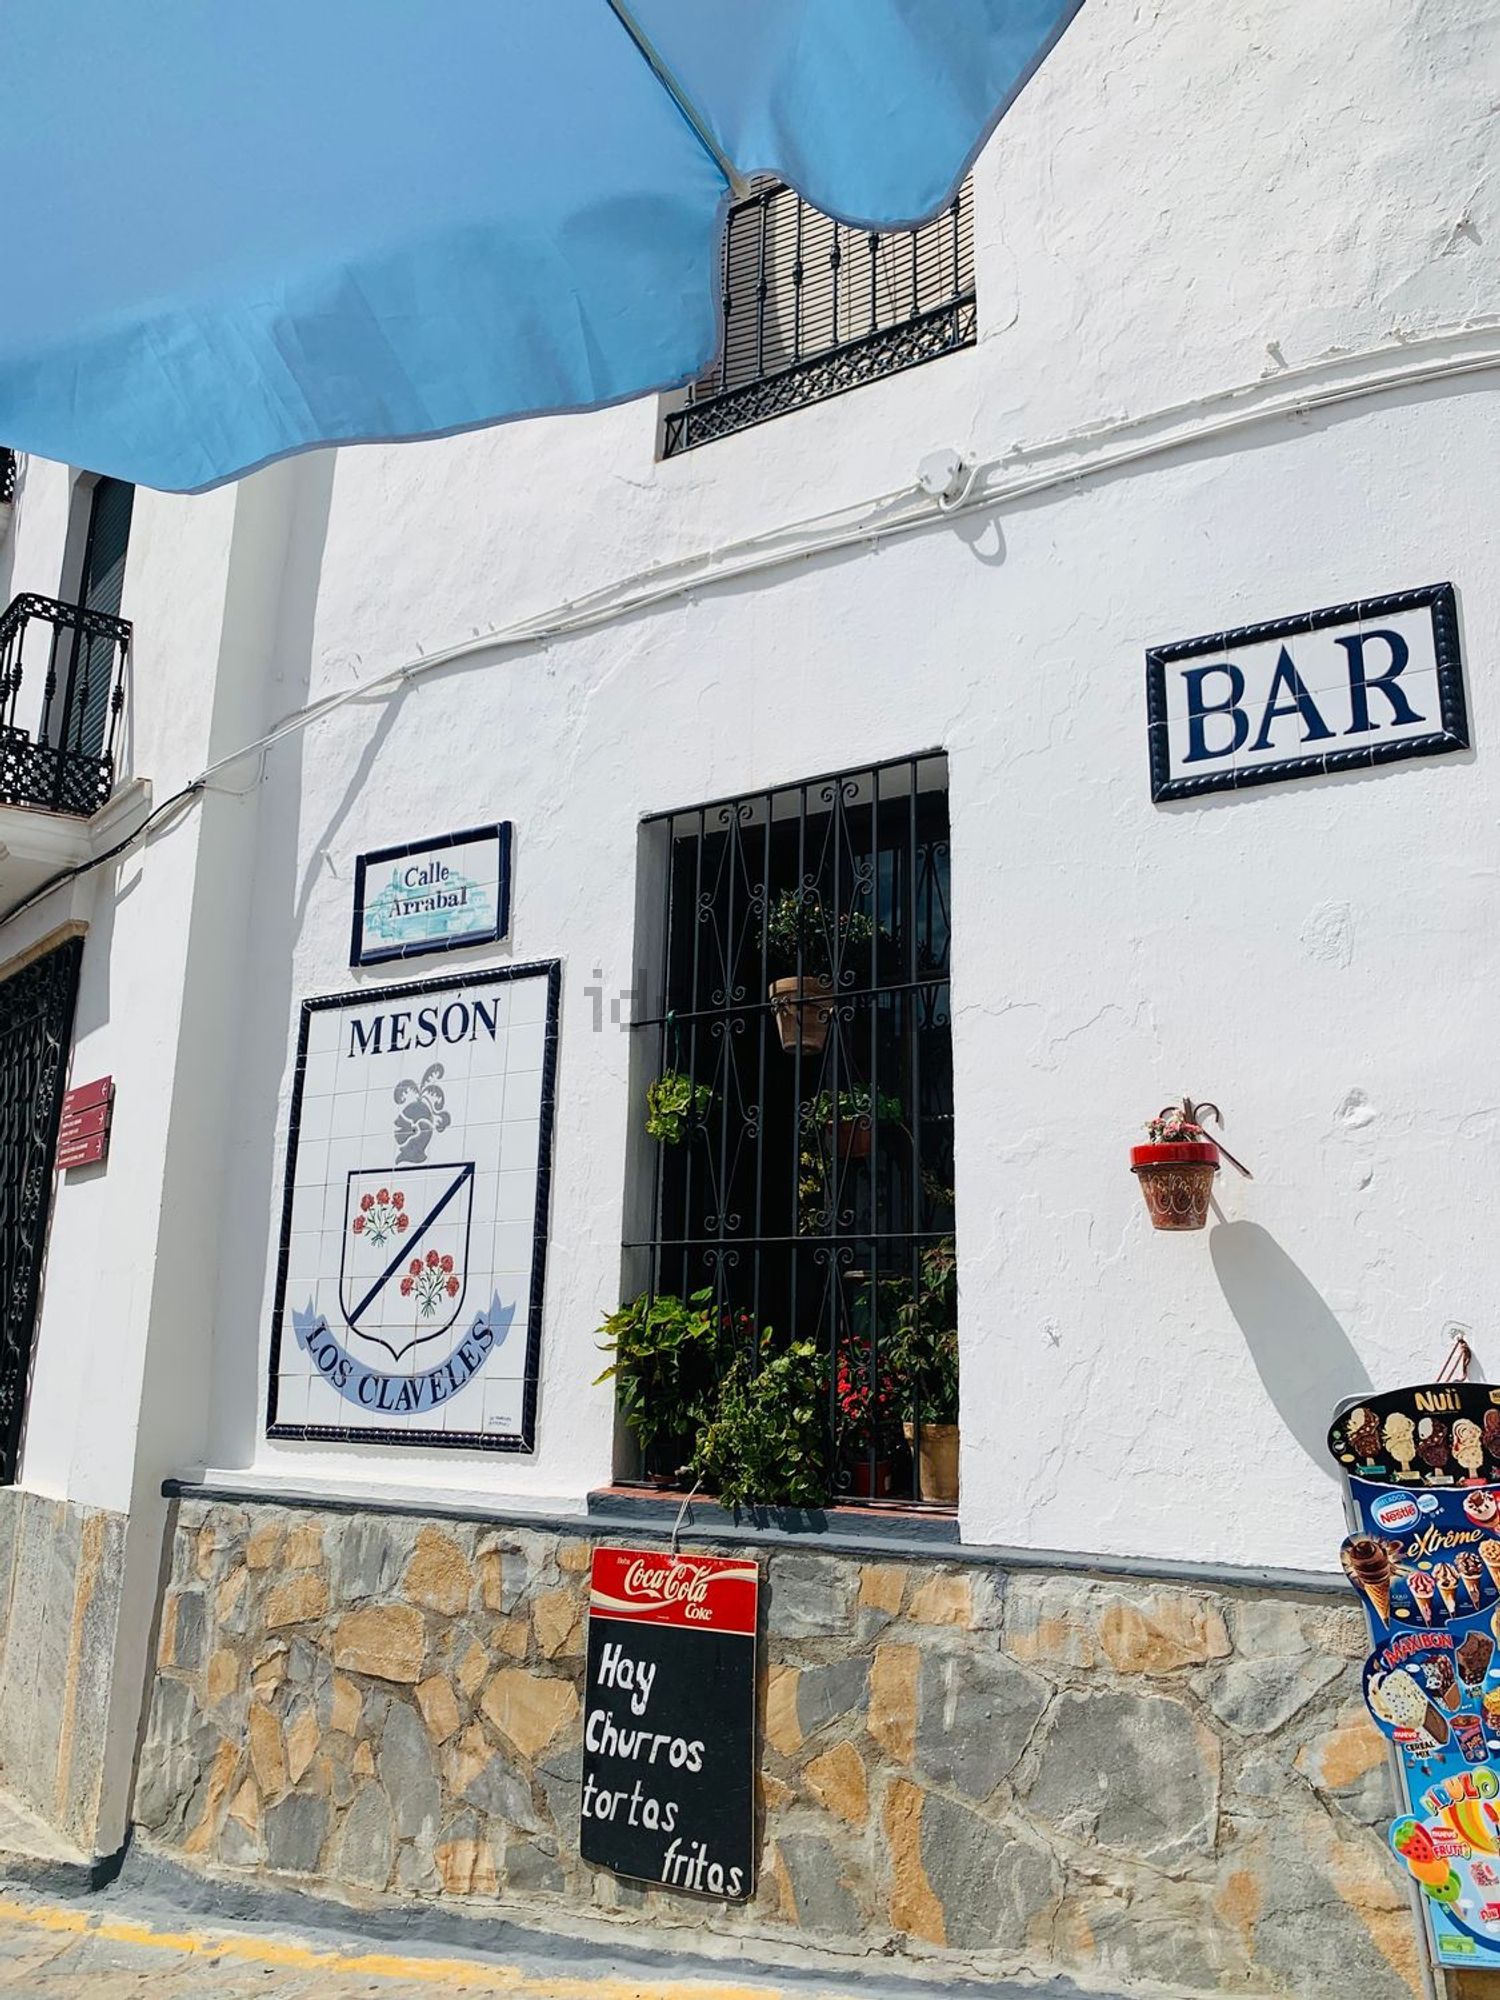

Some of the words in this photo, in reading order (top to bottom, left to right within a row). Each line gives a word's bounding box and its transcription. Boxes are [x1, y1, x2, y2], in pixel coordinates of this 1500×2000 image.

[1179, 628, 1427, 765] BAR
[389, 886, 468, 918] Arrabal
[404, 861, 449, 888] Calle
[346, 992, 502, 1059] MESÓN
[305, 1322, 354, 1389] LOS
[357, 1318, 495, 1412] CLAVELES
[1380, 1503, 1416, 1524] Nestlé
[623, 1558, 712, 1603] Coca-Cola
[684, 1602, 713, 1621] Coke
[597, 1642, 656, 1716] Hay
[1381, 1632, 1455, 1671] MAXIBON
[585, 1709, 705, 1773] Churros
[581, 1773, 679, 1833] tortas
[661, 1837, 744, 1897] fritas
